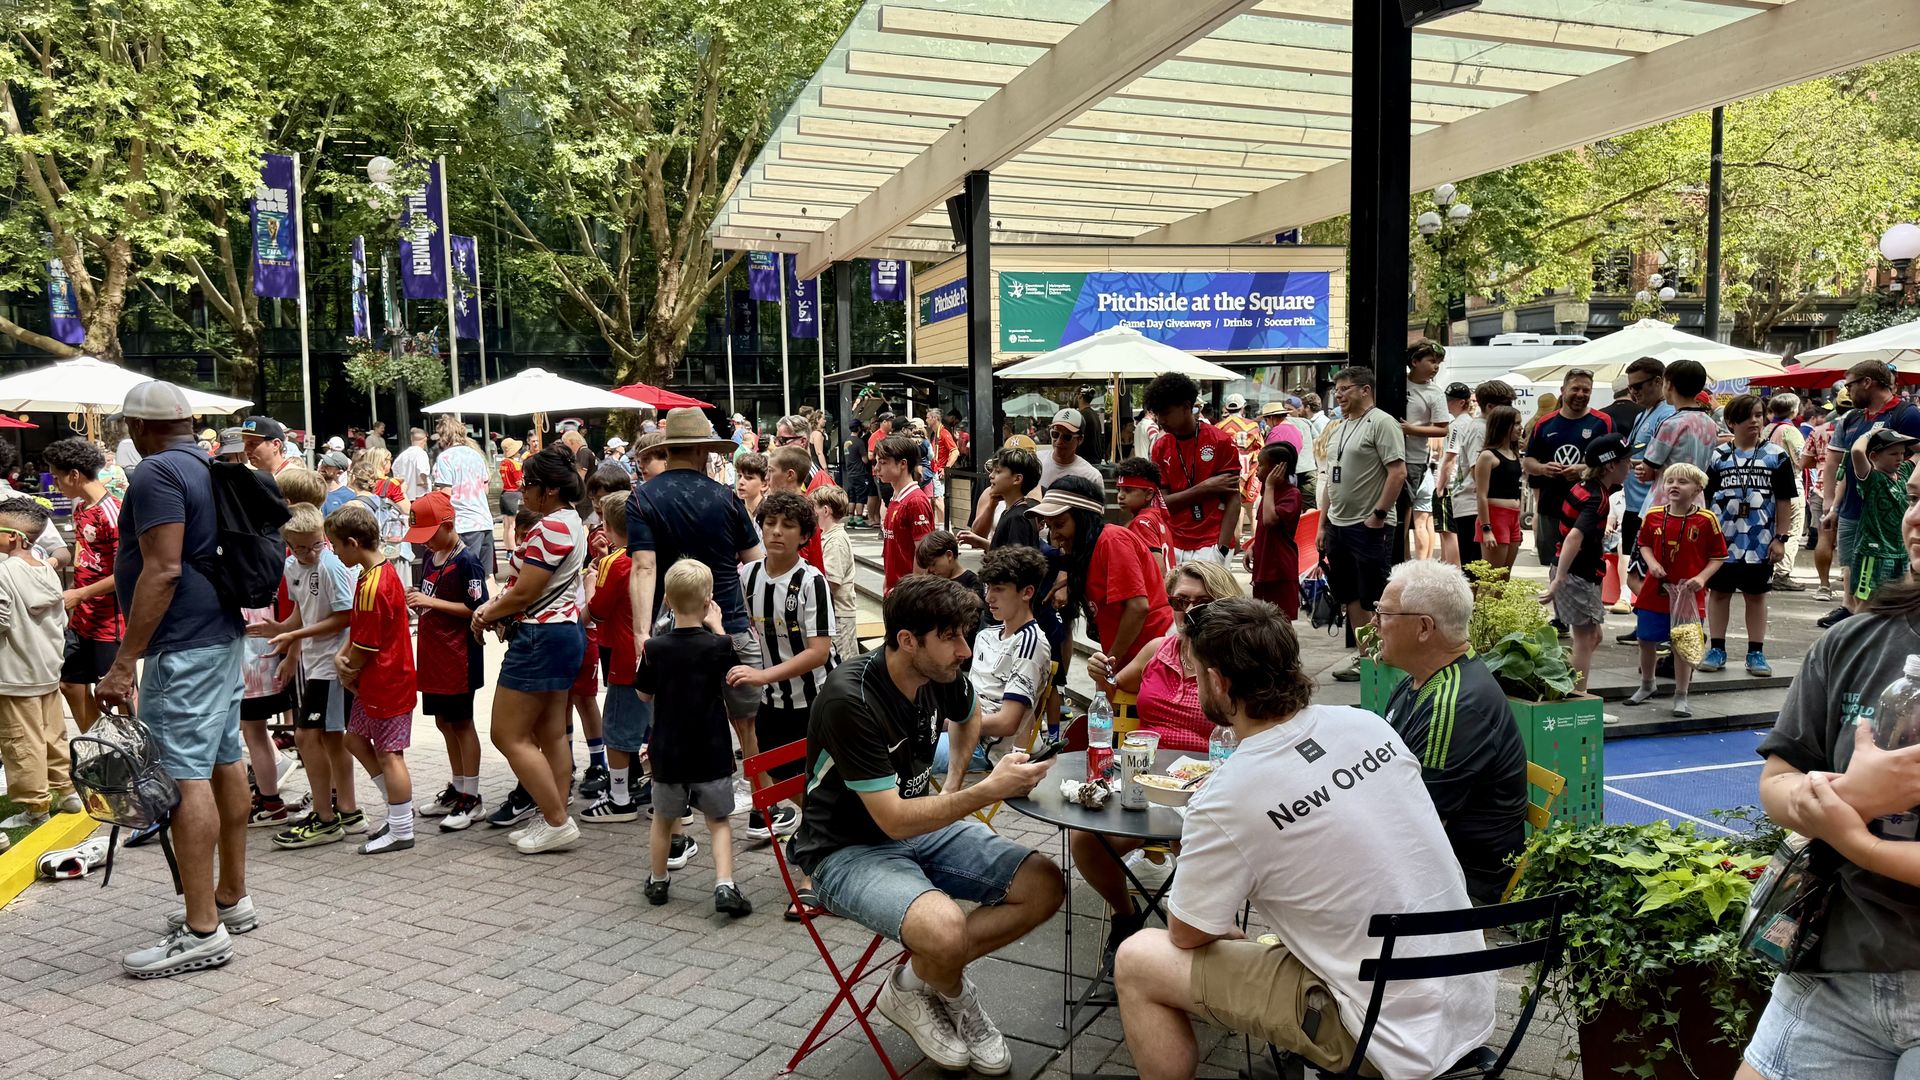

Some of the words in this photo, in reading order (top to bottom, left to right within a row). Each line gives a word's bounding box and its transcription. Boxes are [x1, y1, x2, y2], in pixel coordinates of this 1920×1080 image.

[408, 183, 432, 275] WILLOMMEN
[258, 259, 291, 267] SEATTLE
[878, 258, 900, 285] ŠLI
[934, 289, 961, 314] Pitchside
[1097, 291, 1188, 312] Pitchside
[1191, 293, 1210, 312] at
[1214, 292, 1246, 312] the
[1249, 292, 1315, 314] Square
[1119, 319, 1146, 328] Game
[1147, 319, 1164, 330] Day
[1165, 318, 1212, 330] Giveaways
[1223, 317, 1253, 327] Drinks
[1264, 317, 1292, 327] Soccer
[1293, 316, 1316, 327] Pitch
[1266, 785, 1331, 831] New
[1331, 740, 1397, 790] Order
